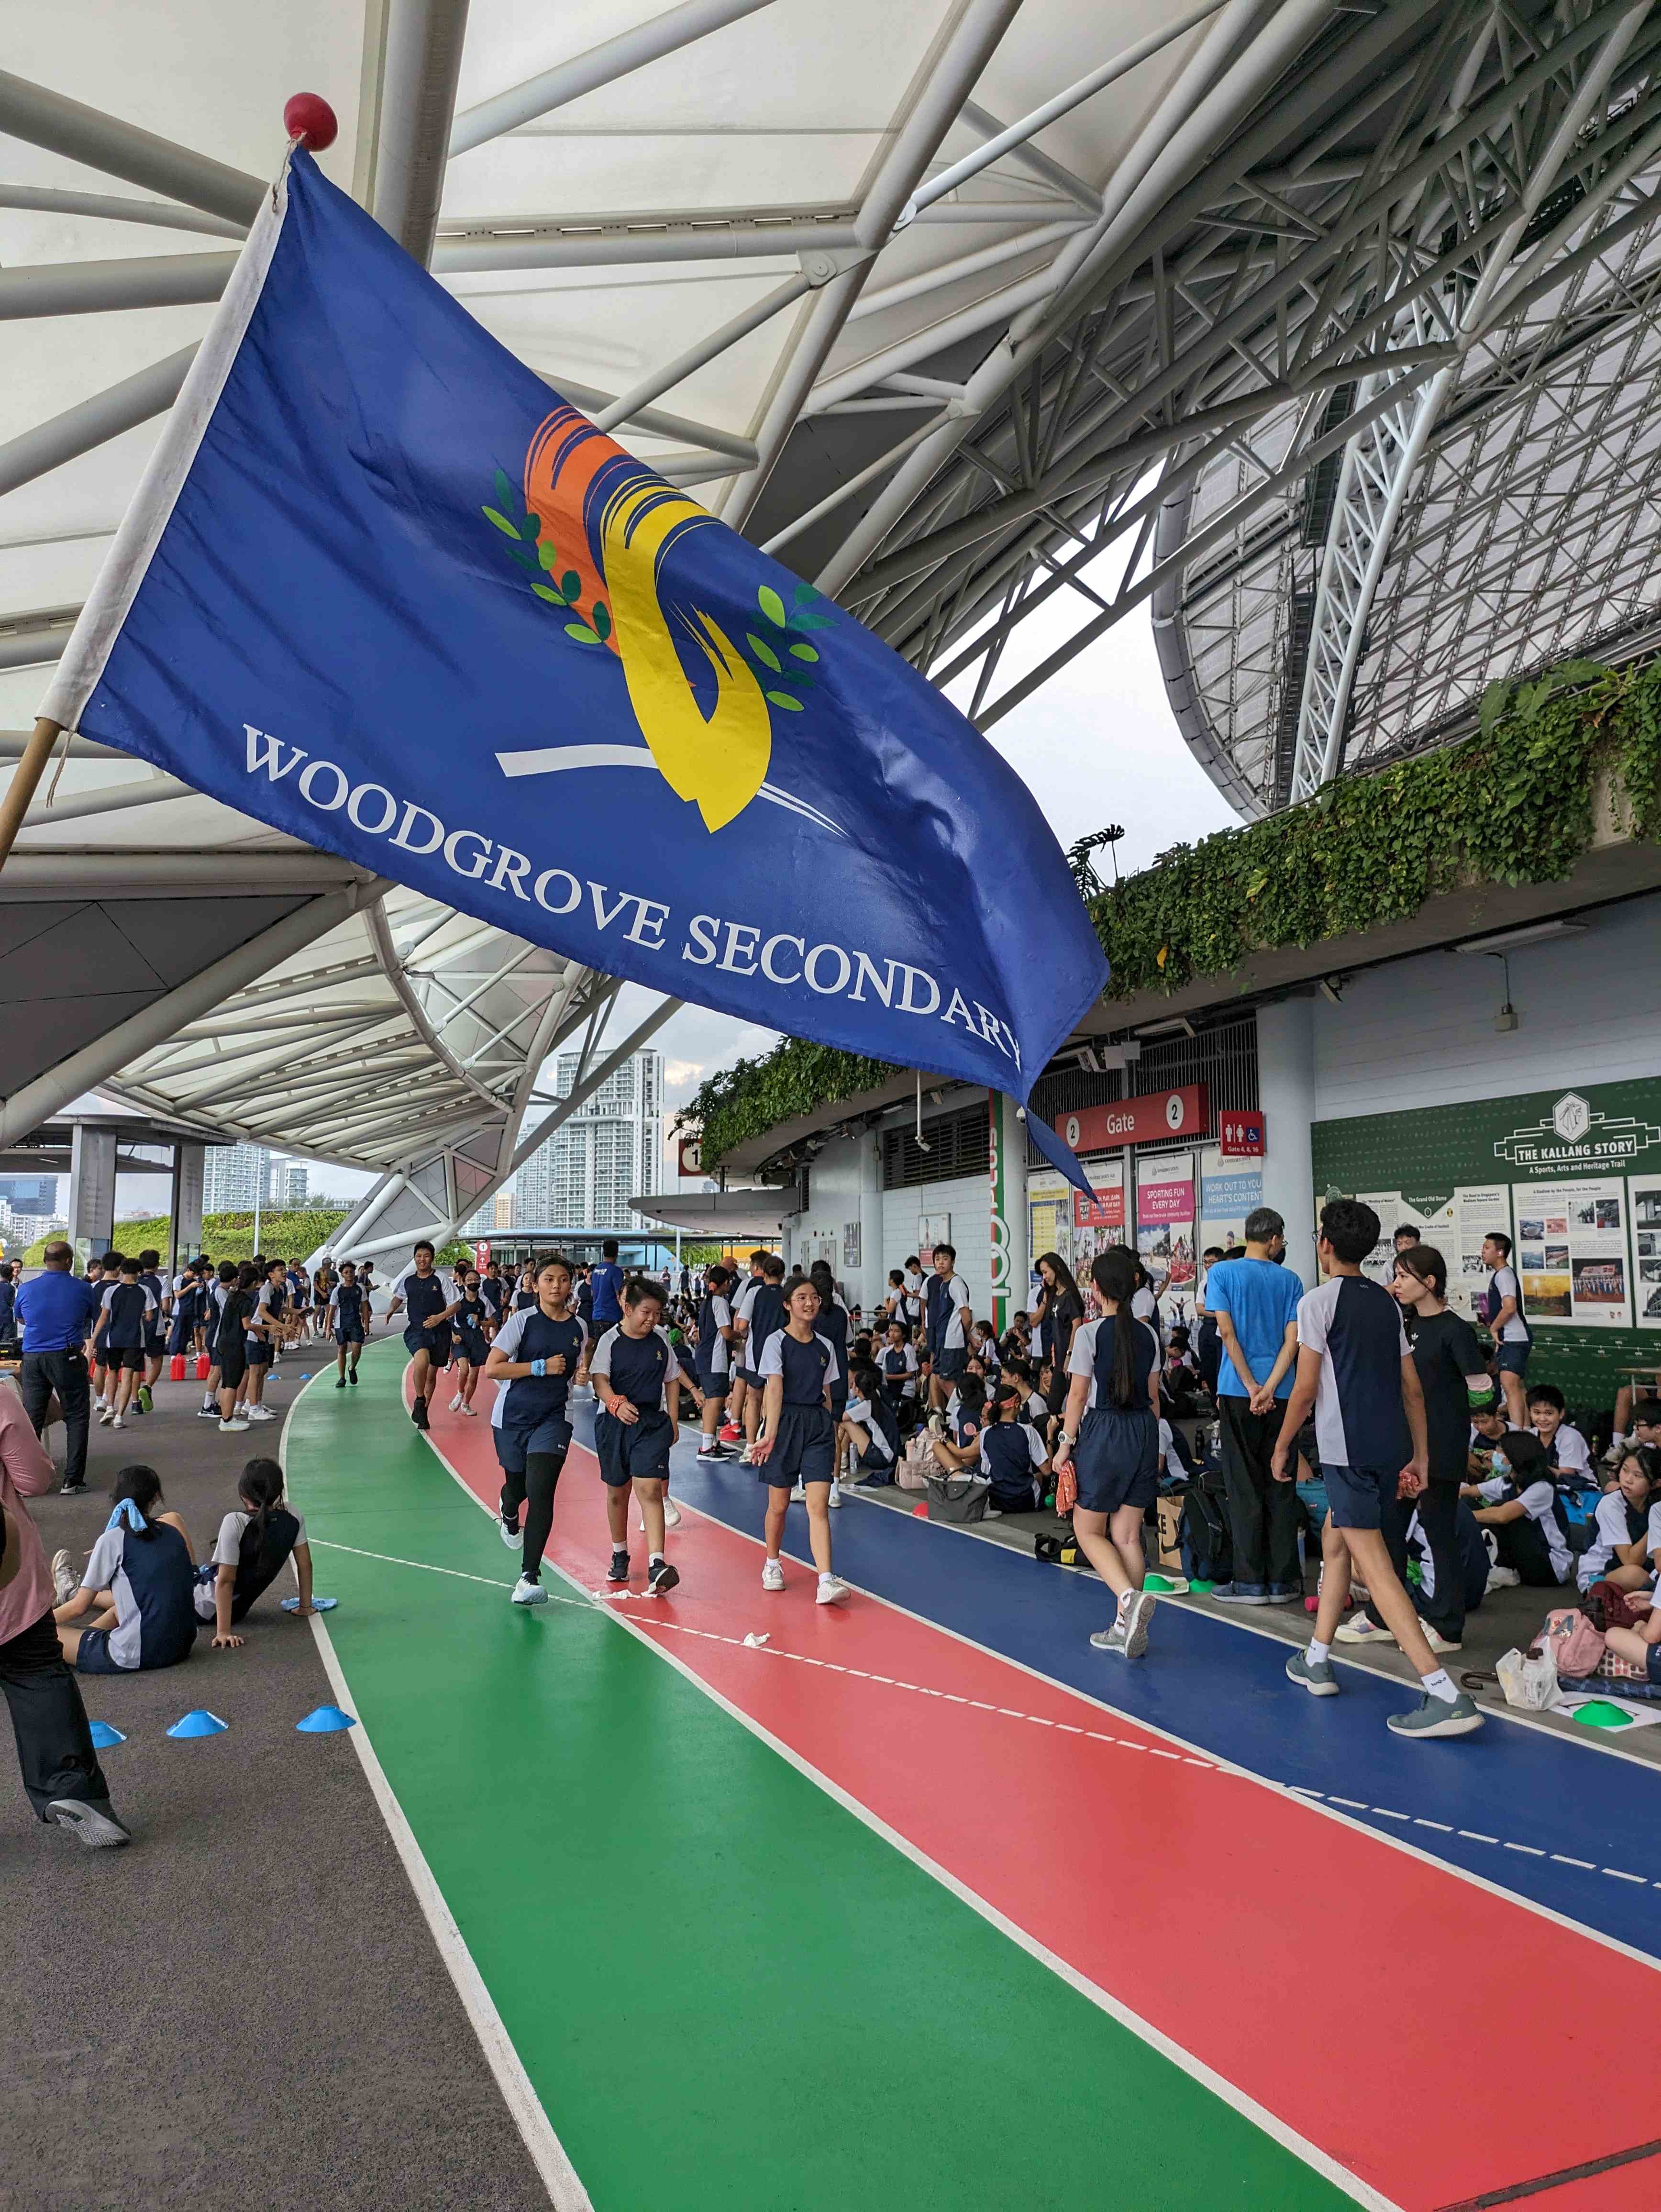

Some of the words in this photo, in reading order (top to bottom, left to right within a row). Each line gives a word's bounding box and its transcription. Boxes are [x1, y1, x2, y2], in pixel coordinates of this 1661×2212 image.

[243, 723, 670, 950] WOODGROVE
[682, 914, 1021, 1072] SECONDARY
[1070, 1124, 1075, 1139] 2
[1107, 1113, 1135, 1134] Gate
[1172, 1104, 1178, 1120] 2
[692, 1149, 698, 1165] 1
[1518, 1149, 1538, 1161] THE
[1541, 1145, 1591, 1159] KALLANG
[1595, 1140, 1633, 1155] STORY
[1535, 1165, 1556, 1175] Sports,
[1557, 1164, 1569, 1172] Arts
[1571, 1163, 1582, 1171] and
[1583, 1161, 1610, 1172] Heritage
[1611, 1159, 1626, 1168] Trail
[1147, 1189, 1173, 1199] SPORTING
[1174, 1187, 1185, 1197] FUN
[1206, 1183, 1223, 1193] WORK
[1224, 1181, 1238, 1191] OUT
[1239, 1181, 1246, 1190] TO
[1152, 1200, 1168, 1209] EVERY
[1169, 1199, 1180, 1208] DAY
[1233, 1191, 1262, 1202] CONTENT
